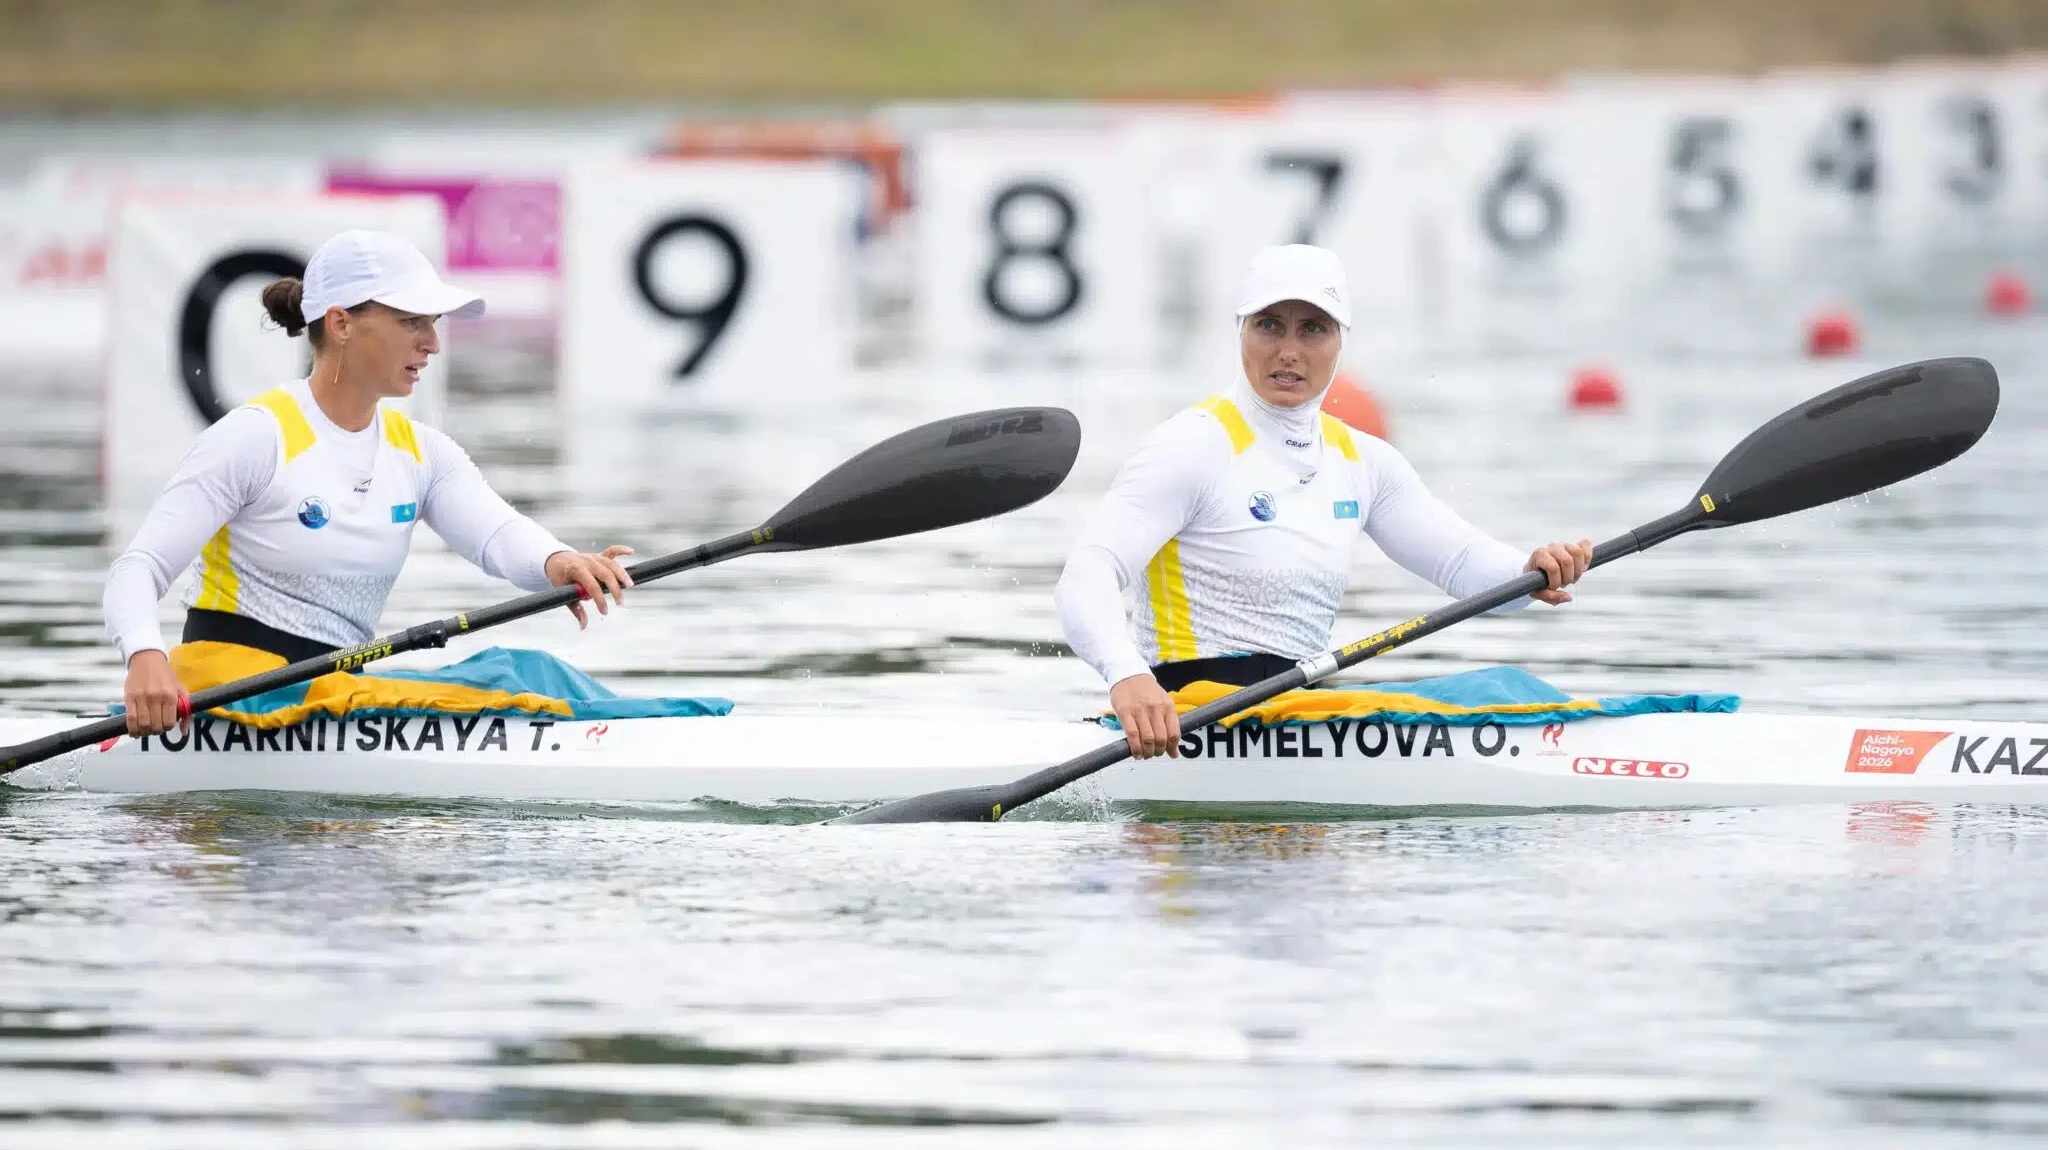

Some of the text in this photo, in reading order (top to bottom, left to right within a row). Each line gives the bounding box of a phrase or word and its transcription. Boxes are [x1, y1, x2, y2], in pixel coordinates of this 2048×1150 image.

[1808, 106, 1880, 200] 4
[1263, 151, 1350, 247] 7
[1480, 138, 1568, 256] 6
[1669, 118, 1742, 238] 5
[983, 182, 1084, 327] 8
[630, 211, 752, 379] 9
[528, 720, 562, 752] T.
[1178, 716, 1520, 759] SHMELYOVA O.
[1860, 744, 1915, 758] Nagoya
[1863, 734, 1905, 746] Aichi-
[1951, 735, 2048, 776] KAZ
[1576, 757, 1687, 779] NELO
[1858, 756, 1893, 768] 2026
